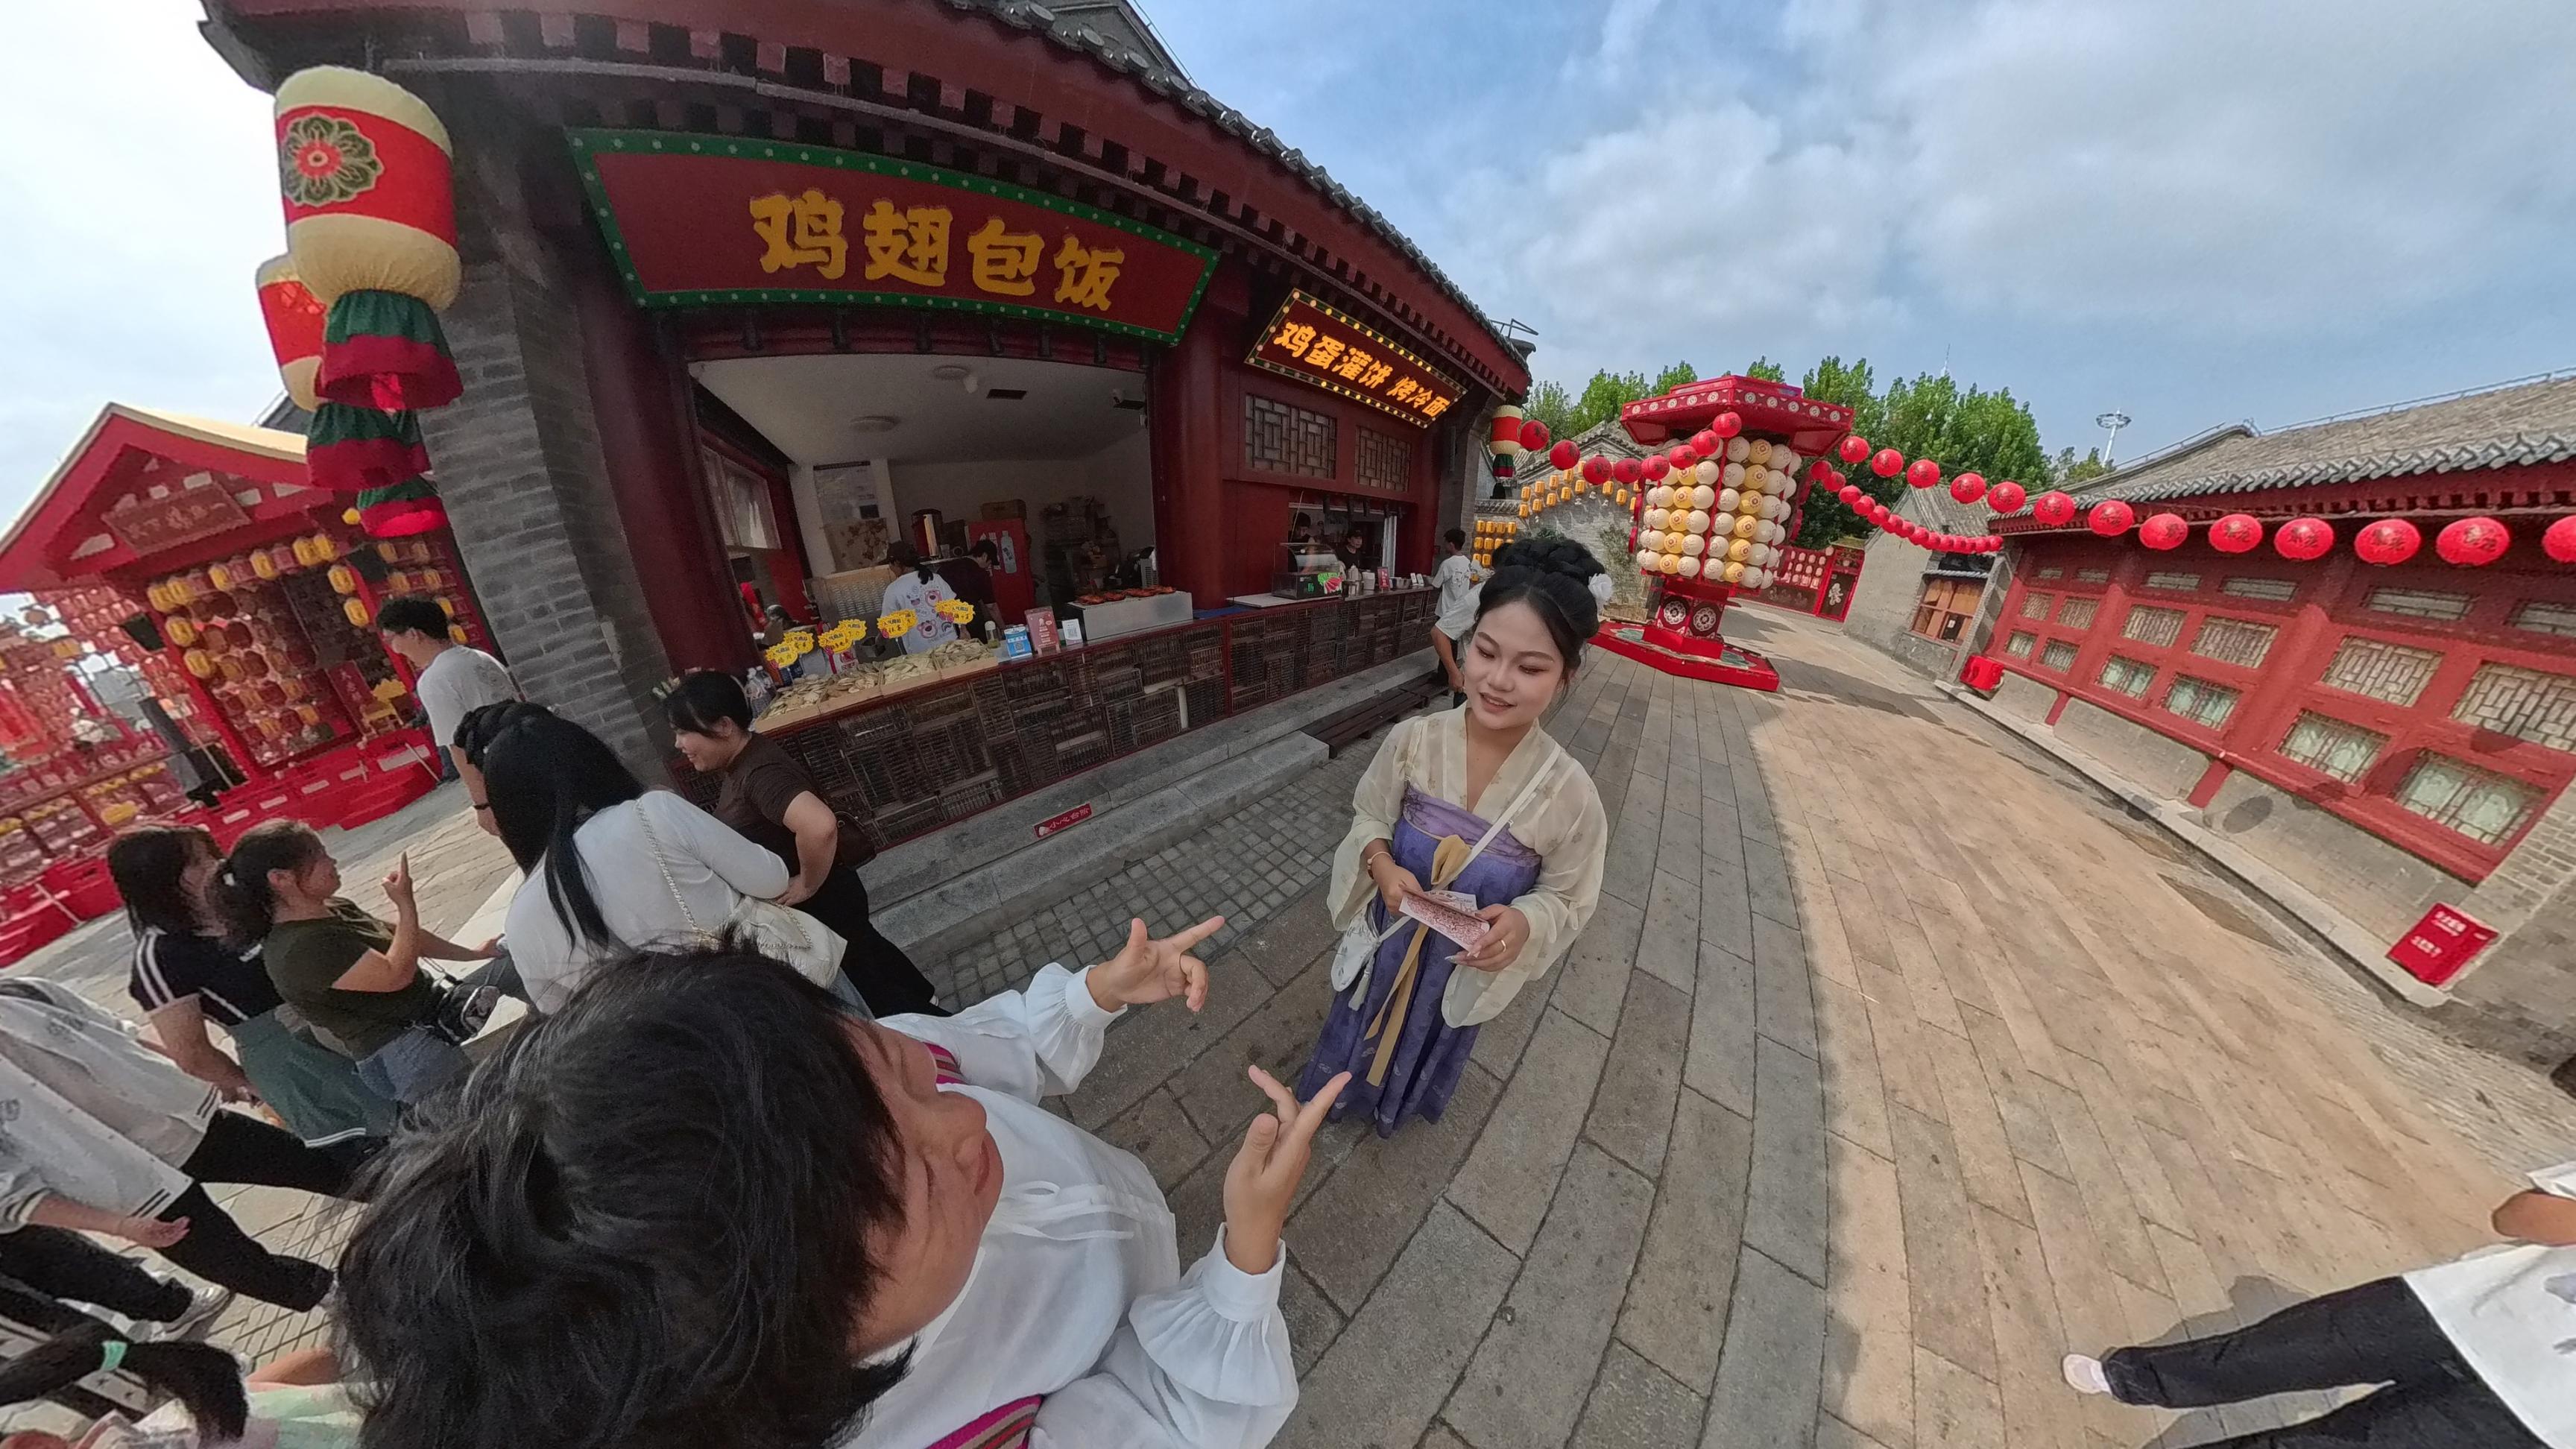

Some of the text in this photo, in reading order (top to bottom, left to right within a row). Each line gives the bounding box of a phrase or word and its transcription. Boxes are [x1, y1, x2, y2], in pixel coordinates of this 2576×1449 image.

[749, 189, 1124, 311] 鸡翅包饭
[1273, 321, 1450, 417] 鸡蛋灌饼 烤冷面
